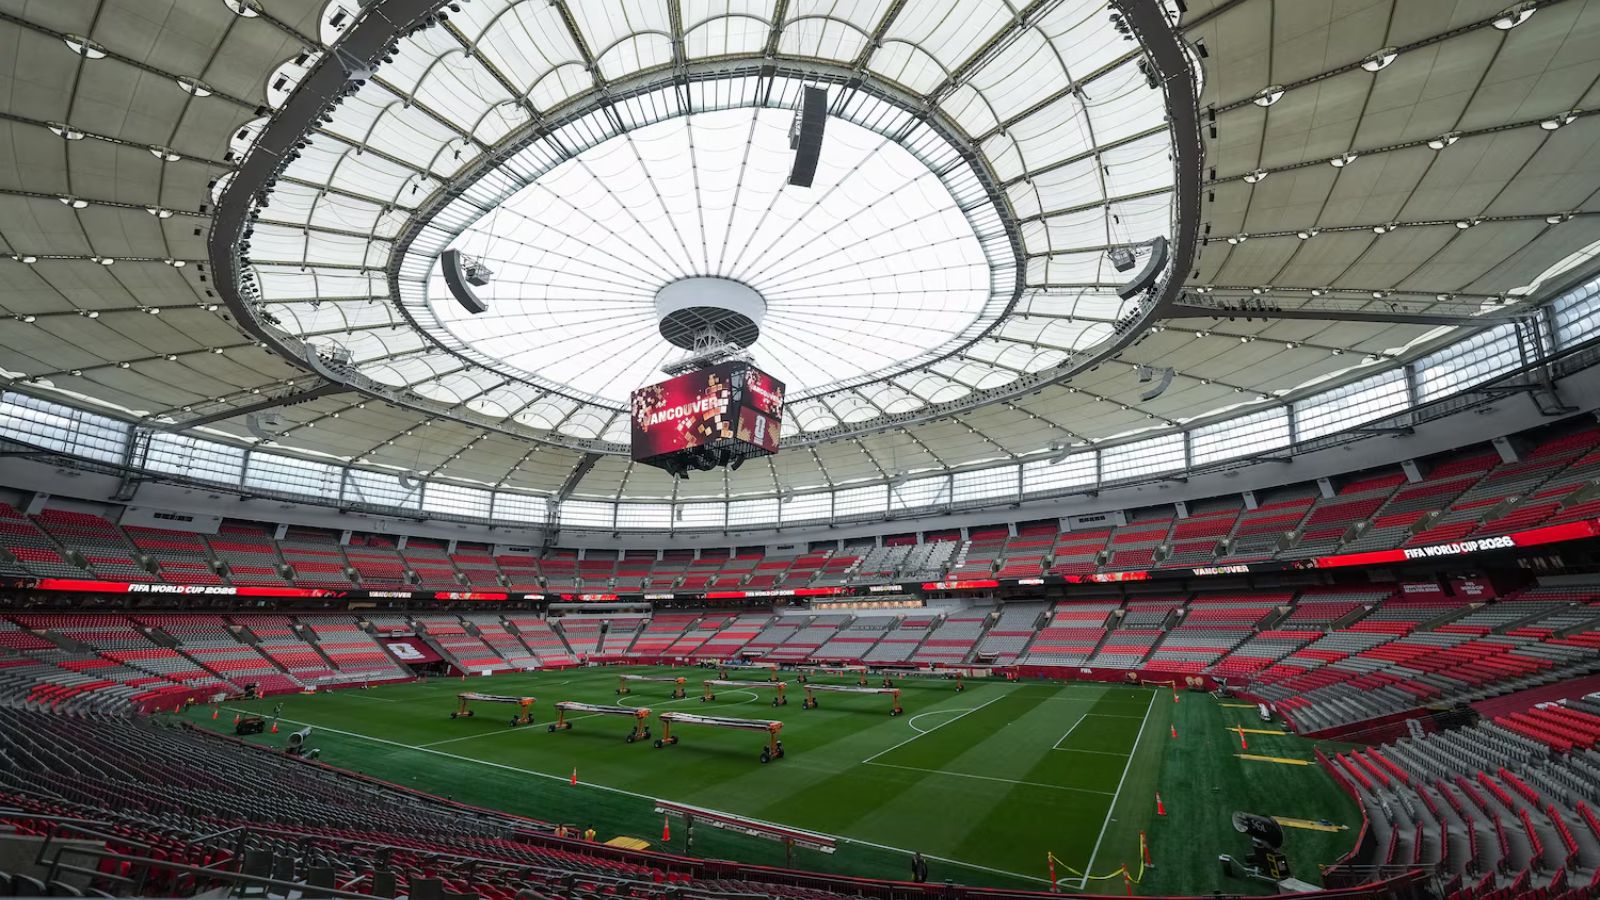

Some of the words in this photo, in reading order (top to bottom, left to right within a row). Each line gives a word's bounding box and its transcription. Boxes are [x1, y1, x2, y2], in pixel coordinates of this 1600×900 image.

[1404, 547, 1426, 559] FIFA
[1424, 543, 1461, 556] WORLD
[1460, 541, 1479, 553] CUP
[1478, 536, 1515, 550] 2026
[1192, 565, 1249, 576] VANCOUVER
[128, 584, 150, 592] FIFA
[151, 585, 184, 593] WORLD
[184, 586, 205, 594] CUP
